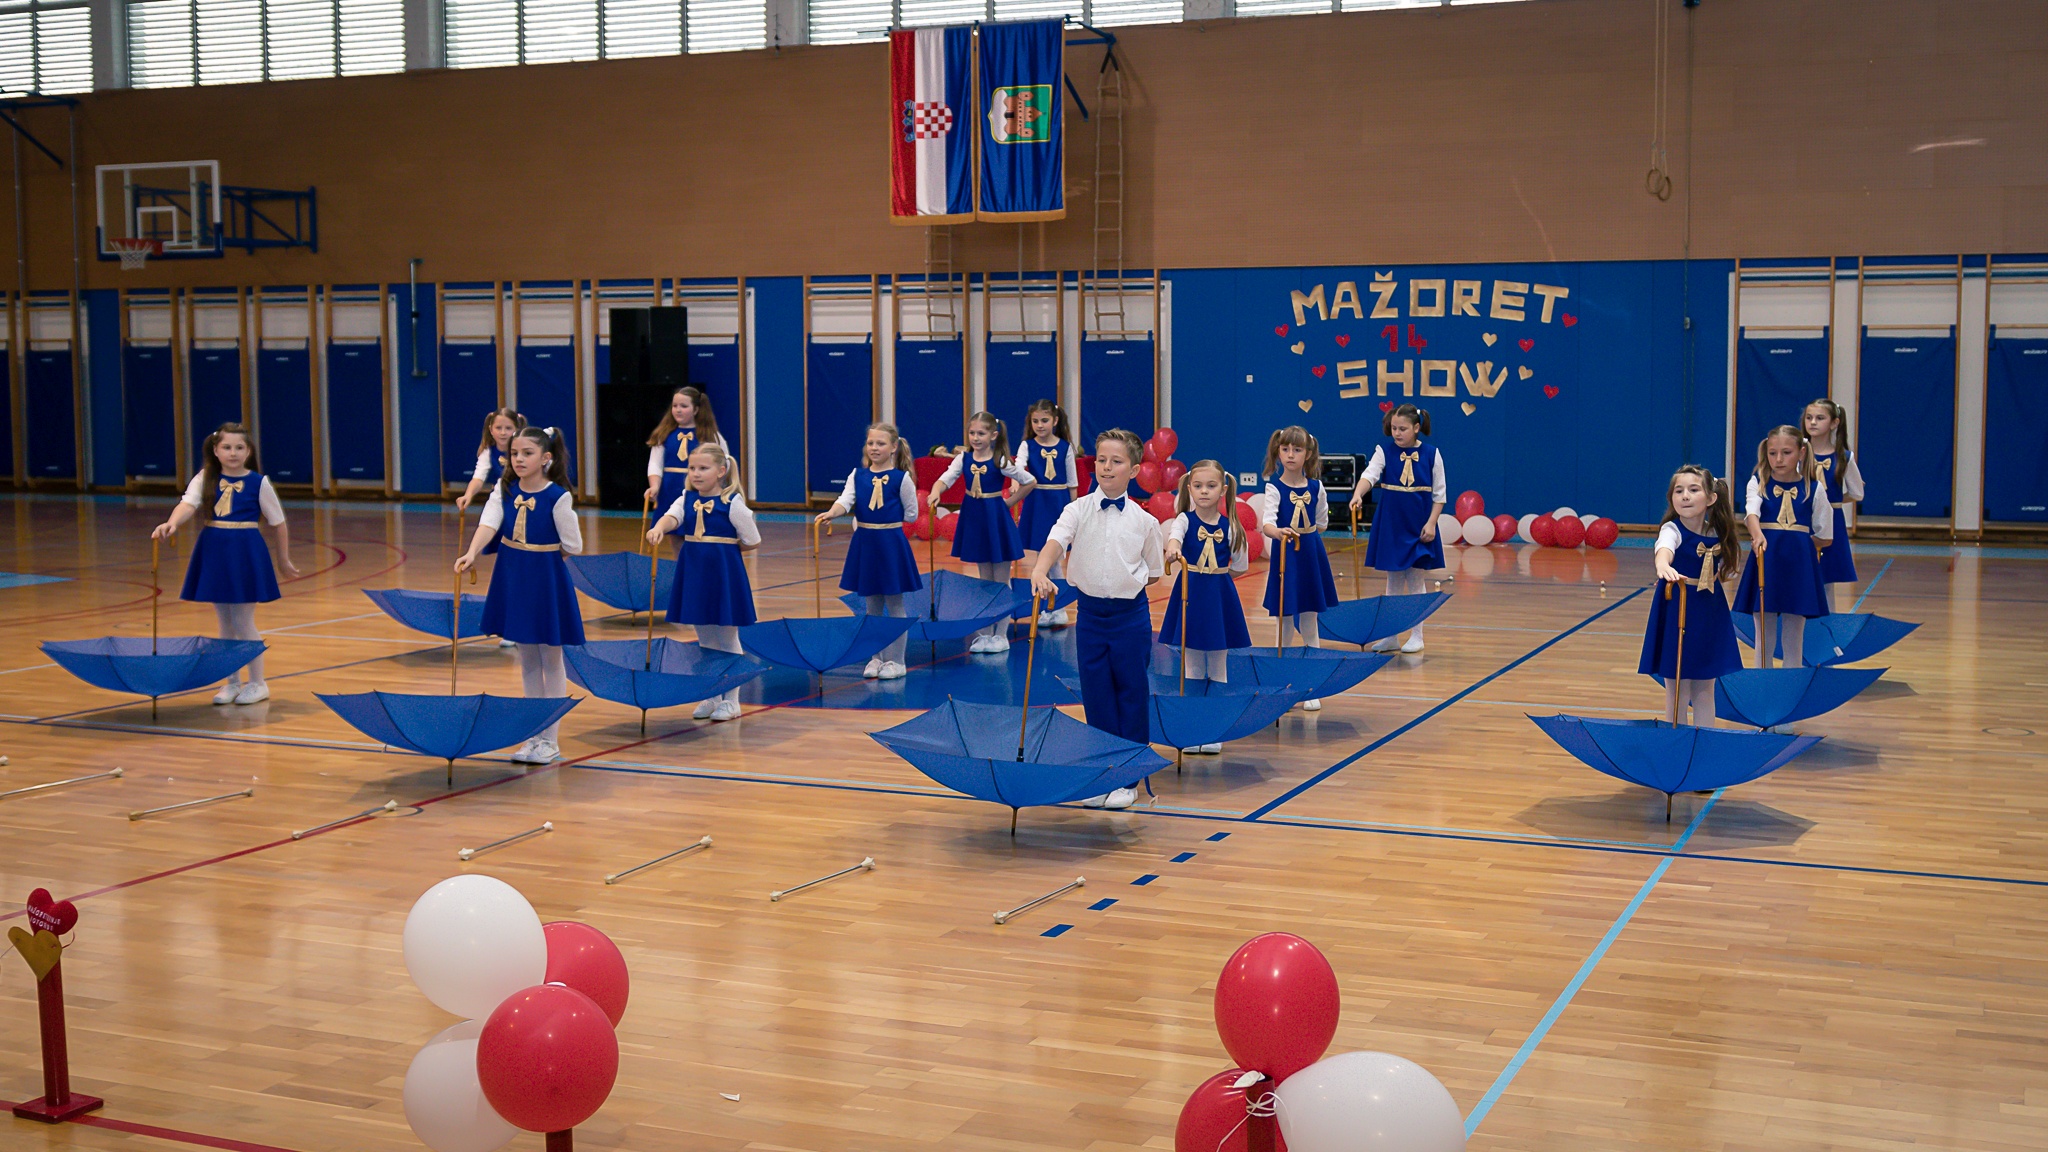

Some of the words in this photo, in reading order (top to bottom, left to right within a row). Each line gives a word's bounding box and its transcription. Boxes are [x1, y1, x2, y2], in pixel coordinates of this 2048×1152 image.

[1290, 270, 1569, 326] MAŽORET
[1381, 324, 1427, 354] 14
[1337, 360, 1508, 398] SHOW
